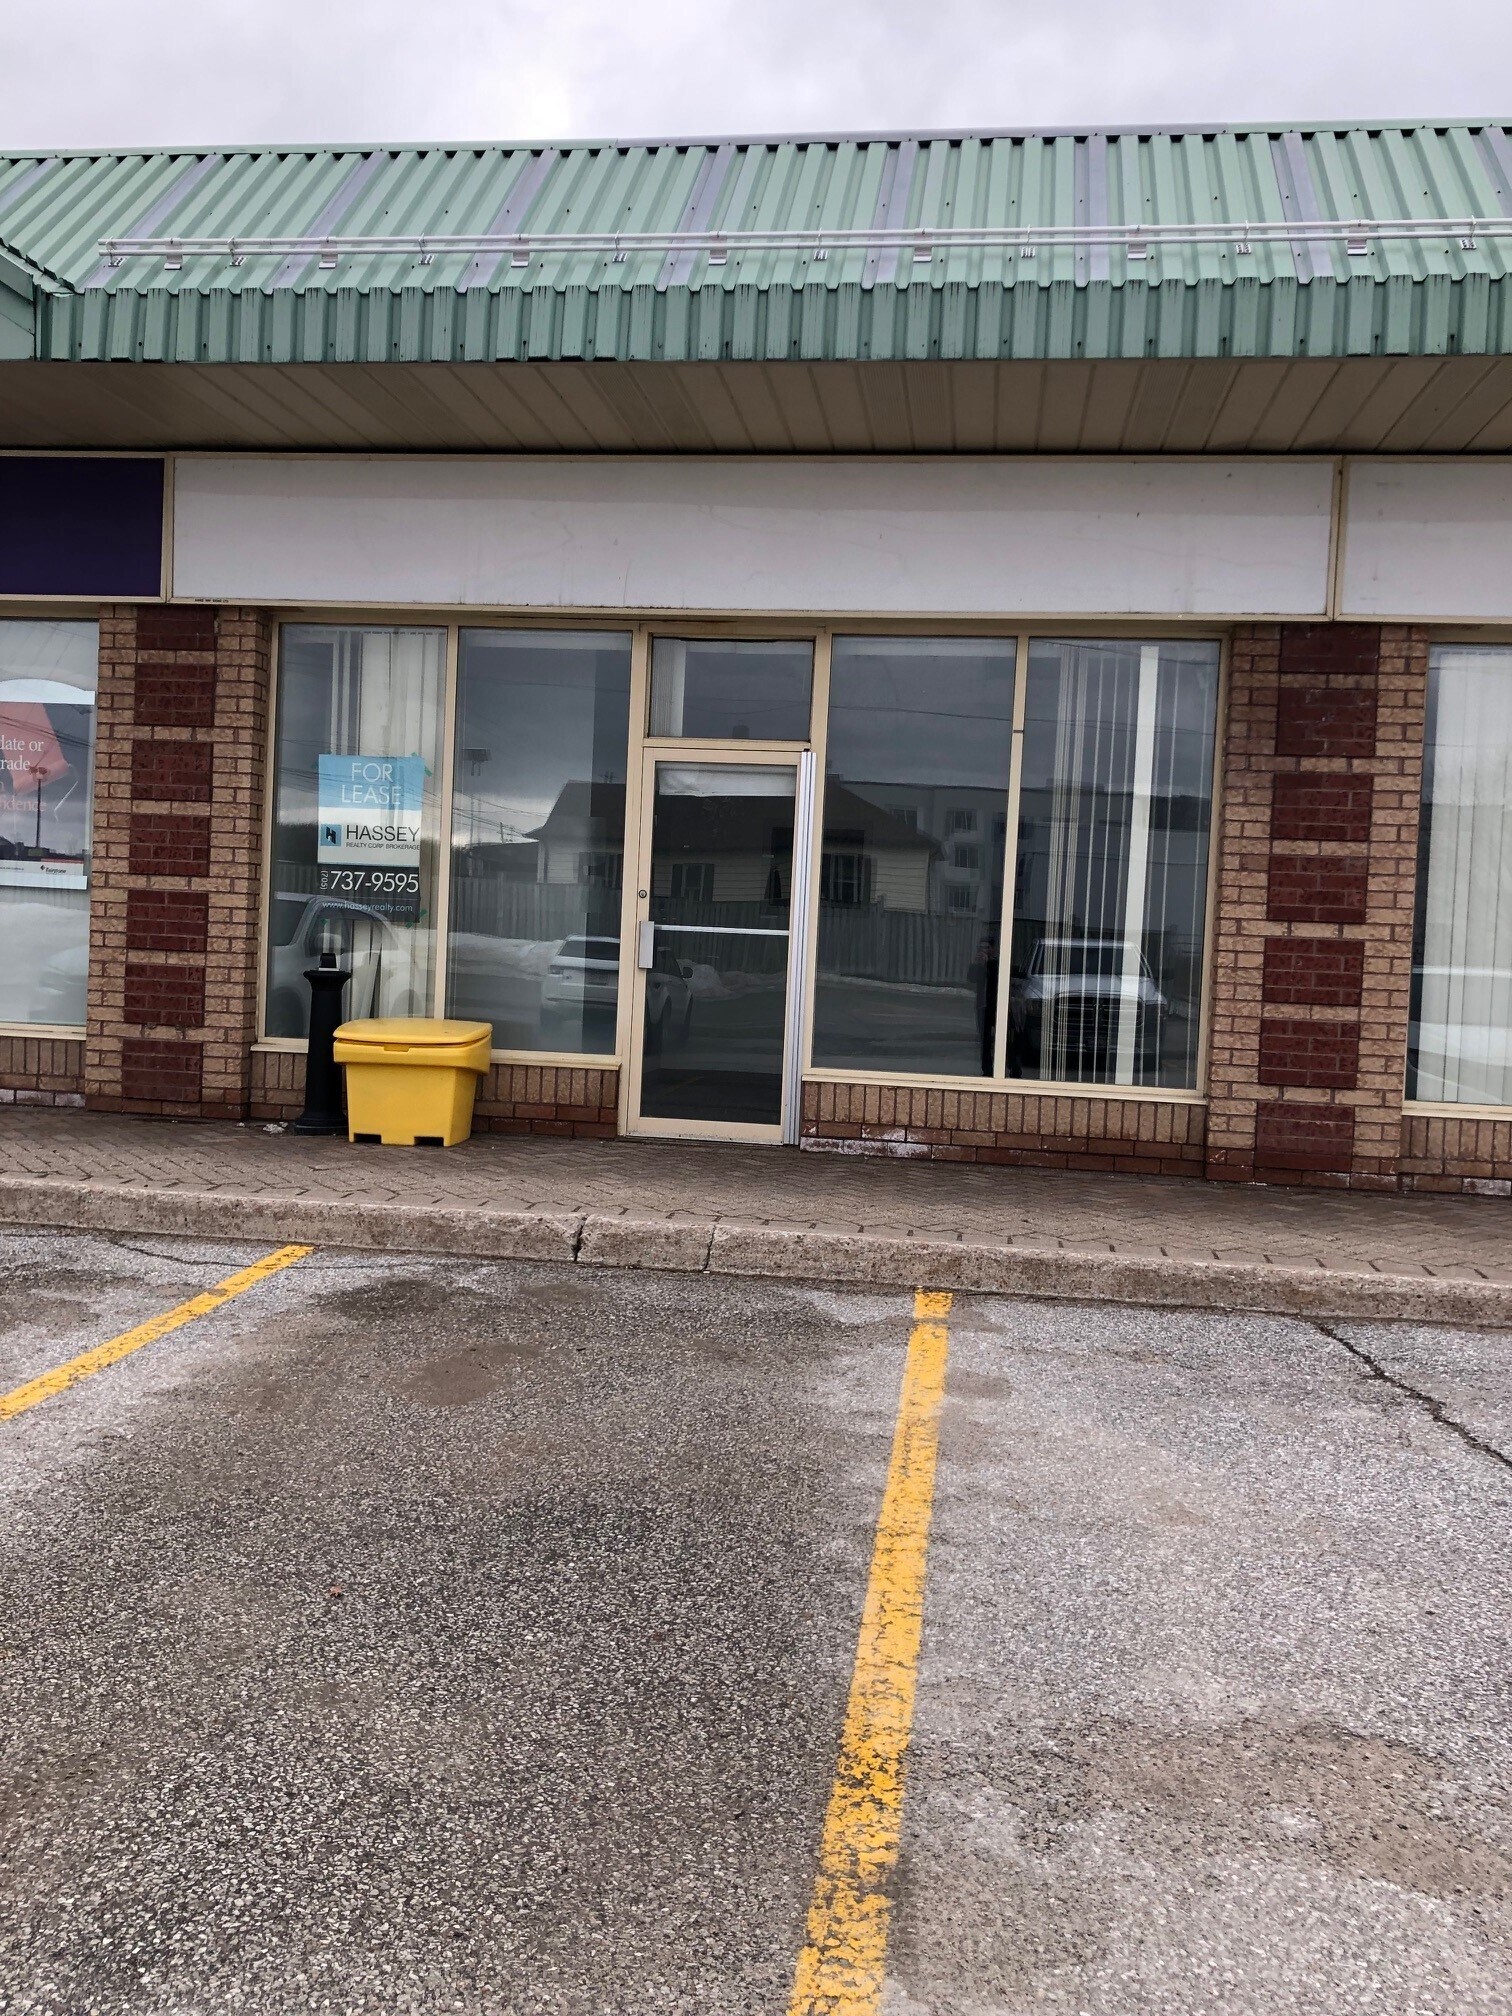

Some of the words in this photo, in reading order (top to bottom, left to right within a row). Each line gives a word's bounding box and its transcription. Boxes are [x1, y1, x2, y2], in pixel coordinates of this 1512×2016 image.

[28, 740, 44, 752] or
[351, 762, 394, 783] FOR
[341, 784, 402, 805] LEASE
[346, 824, 420, 842] HASSEY
[345, 841, 367, 849] REALTY
[385, 843, 421, 851] BROKERAGE
[319, 870, 329, 890] (705)
[330, 870, 419, 893] 737-9595
[322, 901, 413, 913] www.hasseyrealty.com
